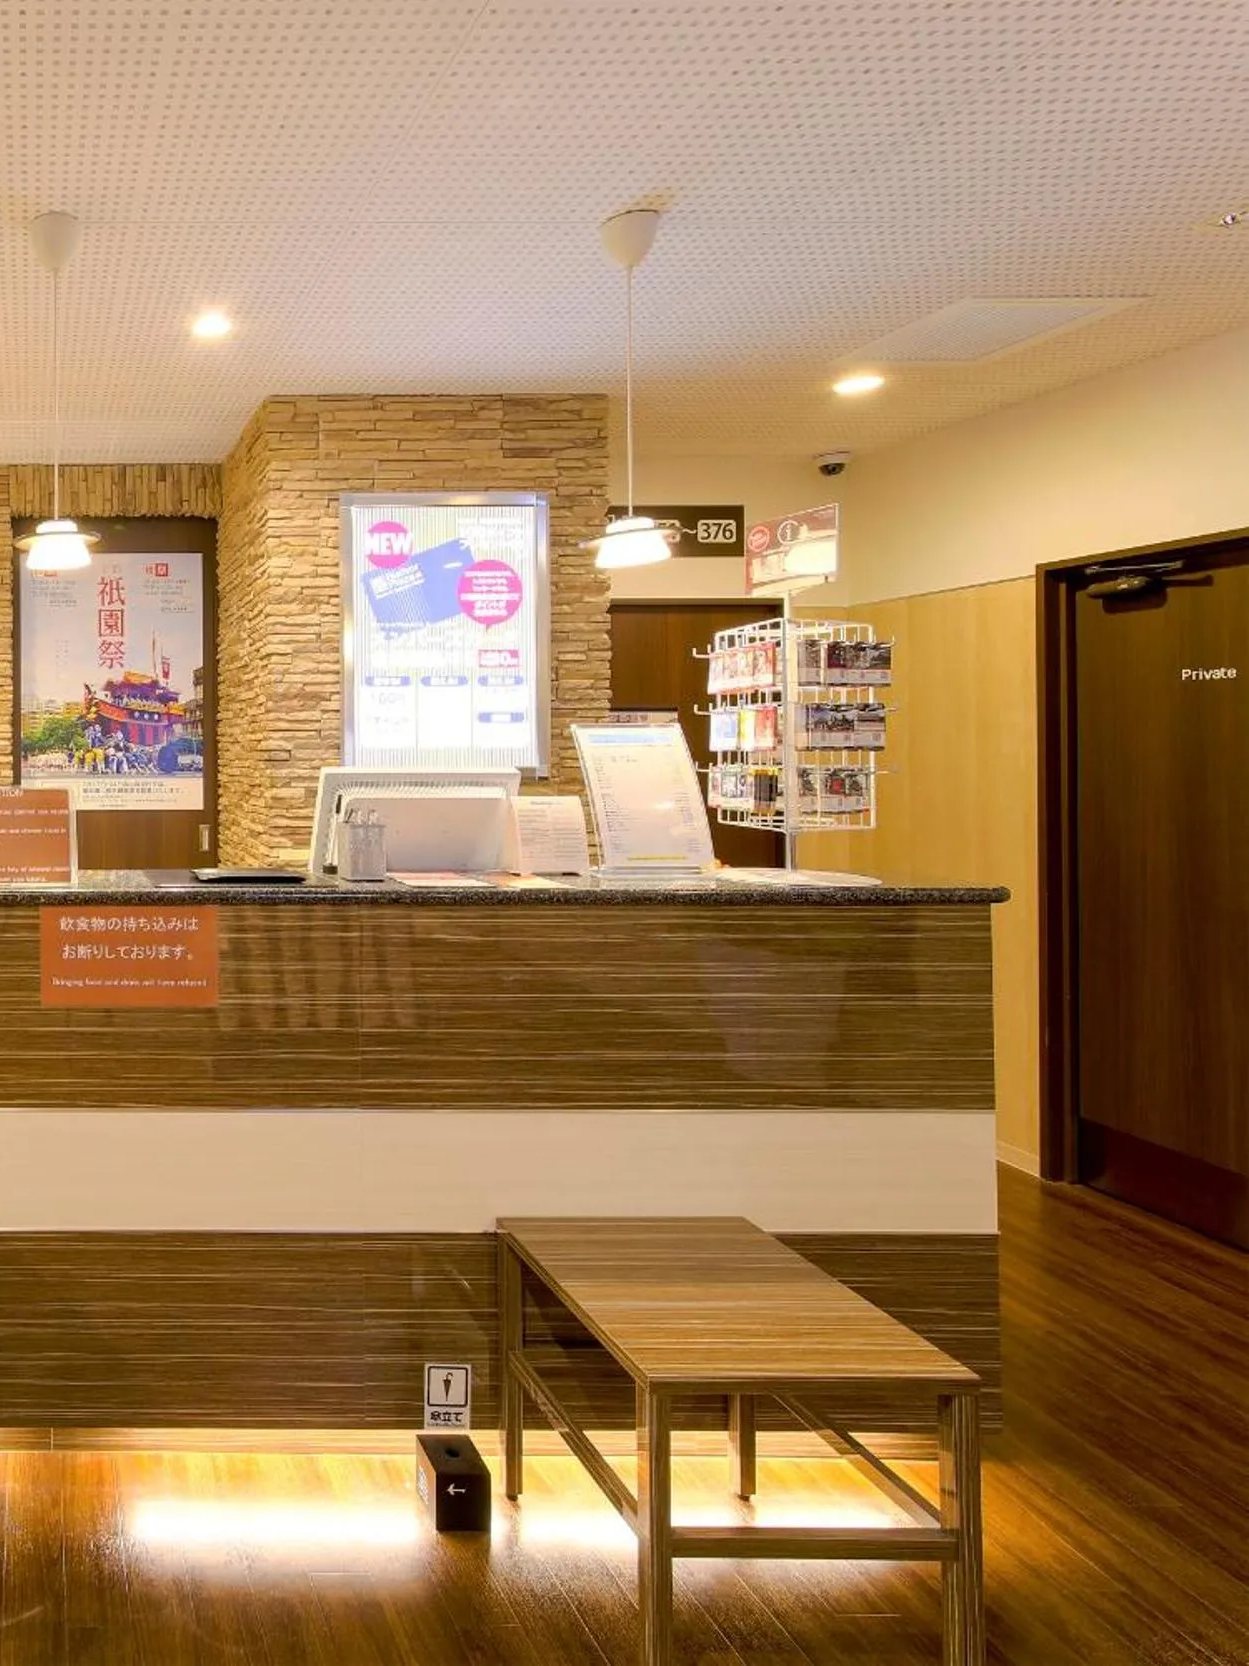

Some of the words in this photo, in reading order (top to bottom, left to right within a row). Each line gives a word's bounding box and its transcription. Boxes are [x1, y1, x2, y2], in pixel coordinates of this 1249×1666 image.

[700, 522, 734, 541] 376
[365, 532, 413, 556] NEW
[1181, 667, 1237, 680] Private
[59, 916, 199, 932] 飲食物の持ち込みは
[62, 943, 193, 960] お断りしております。
